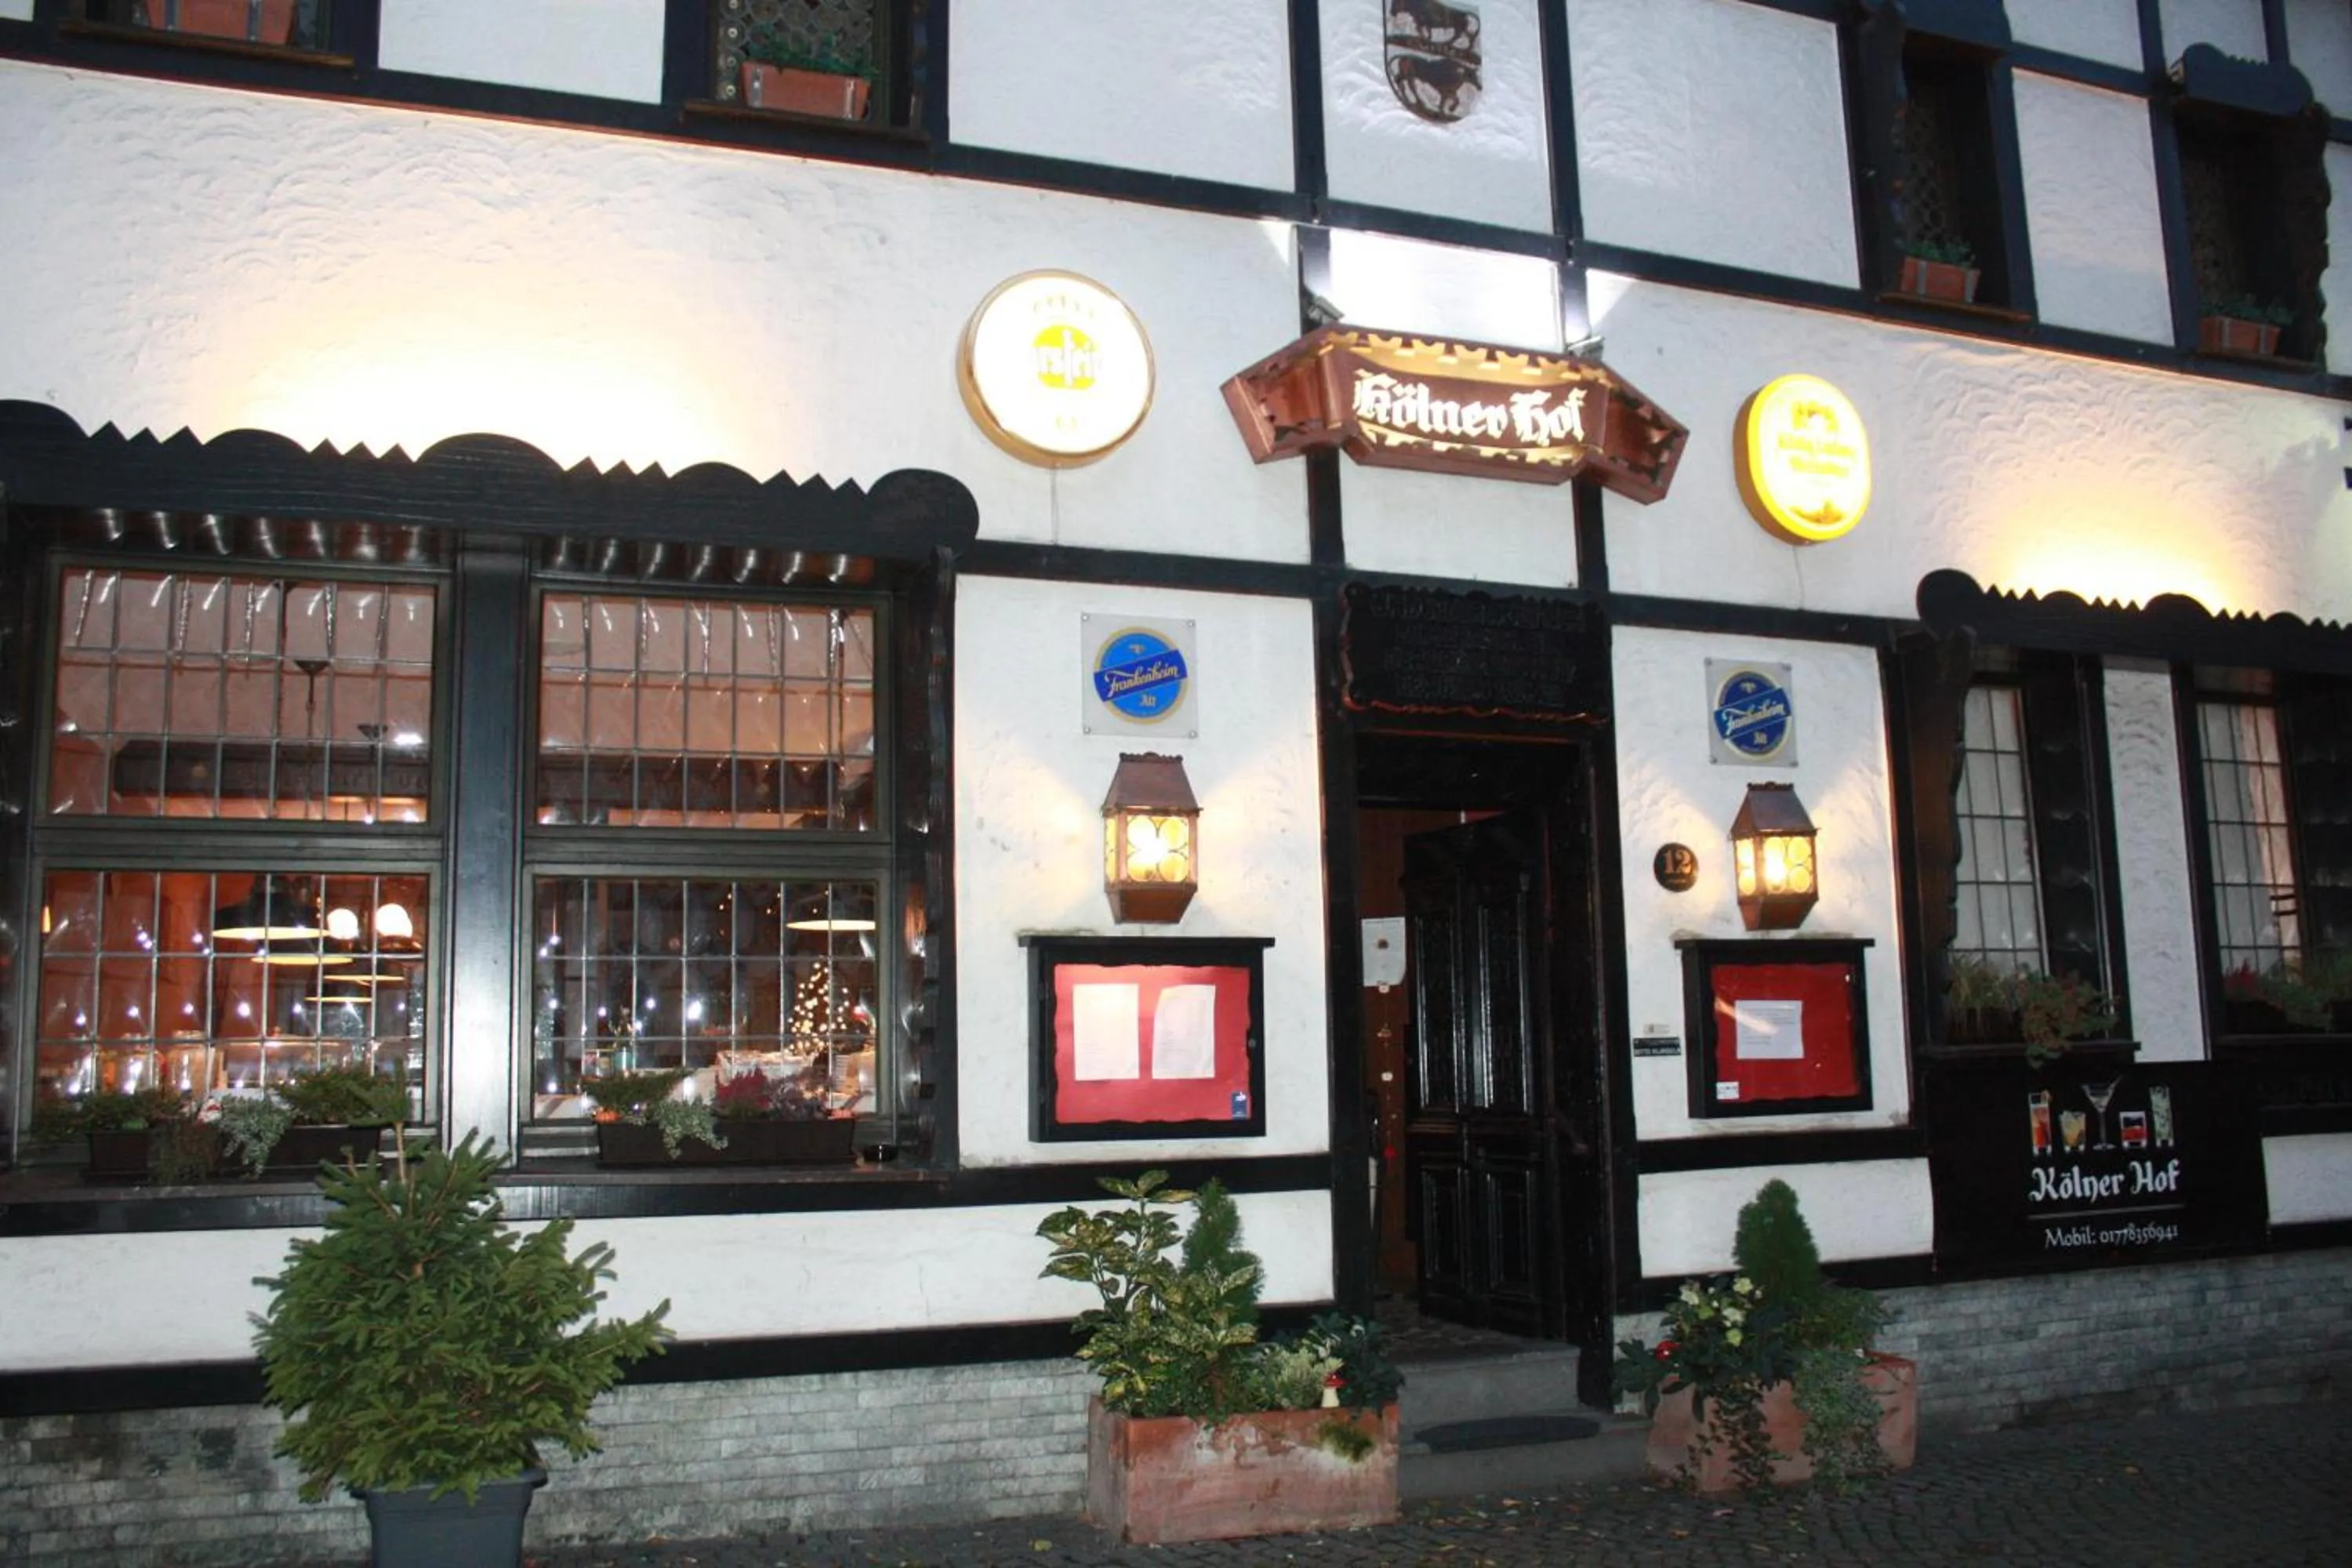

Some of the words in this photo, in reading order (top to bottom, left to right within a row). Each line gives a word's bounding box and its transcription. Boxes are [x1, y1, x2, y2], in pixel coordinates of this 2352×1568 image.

[1352, 368, 1508, 439] Kölner
[1509, 387, 1588, 447] Hof
[1104, 661, 1179, 698] Frankenheim
[1664, 849, 1691, 874] 12
[2028, 1165, 2125, 1203] Kölner
[2129, 1159, 2180, 1195] Hof
[2045, 1225, 2096, 1249] Mobil:
